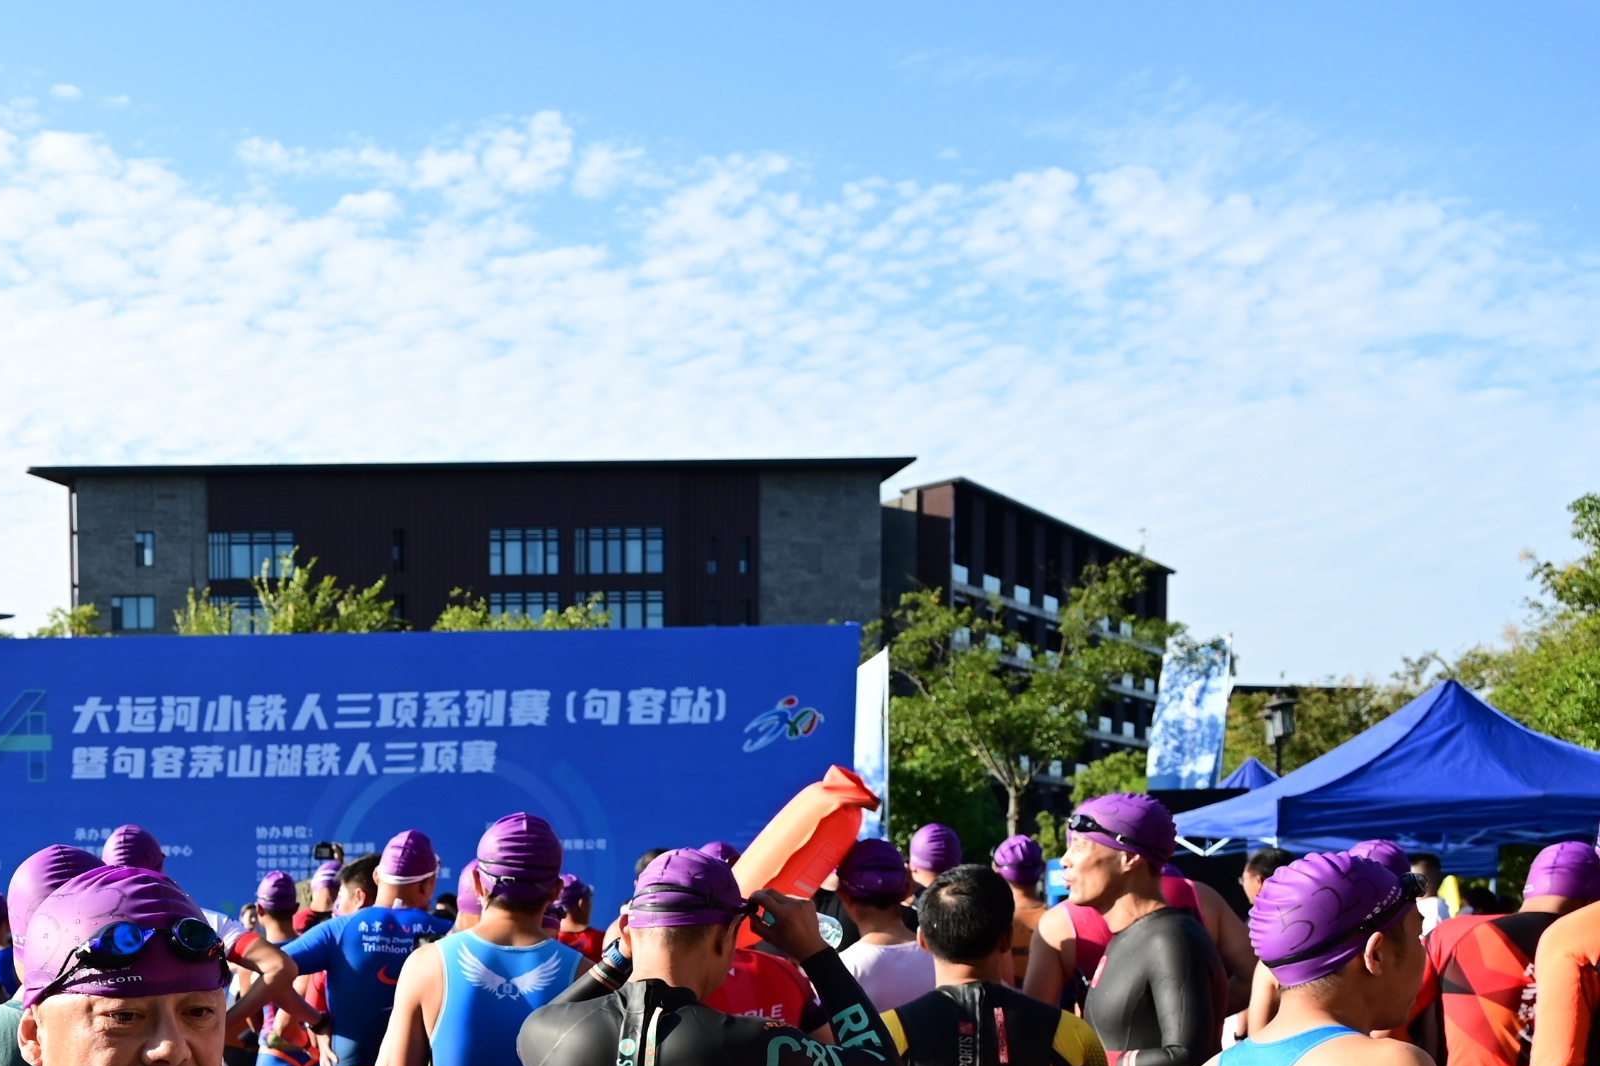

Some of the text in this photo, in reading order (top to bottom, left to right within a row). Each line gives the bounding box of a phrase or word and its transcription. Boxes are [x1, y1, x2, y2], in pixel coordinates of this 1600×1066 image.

[71, 740, 498, 780] 暨句容茅山湖铁人三项赛
[363, 942, 408, 954] Triathlon
